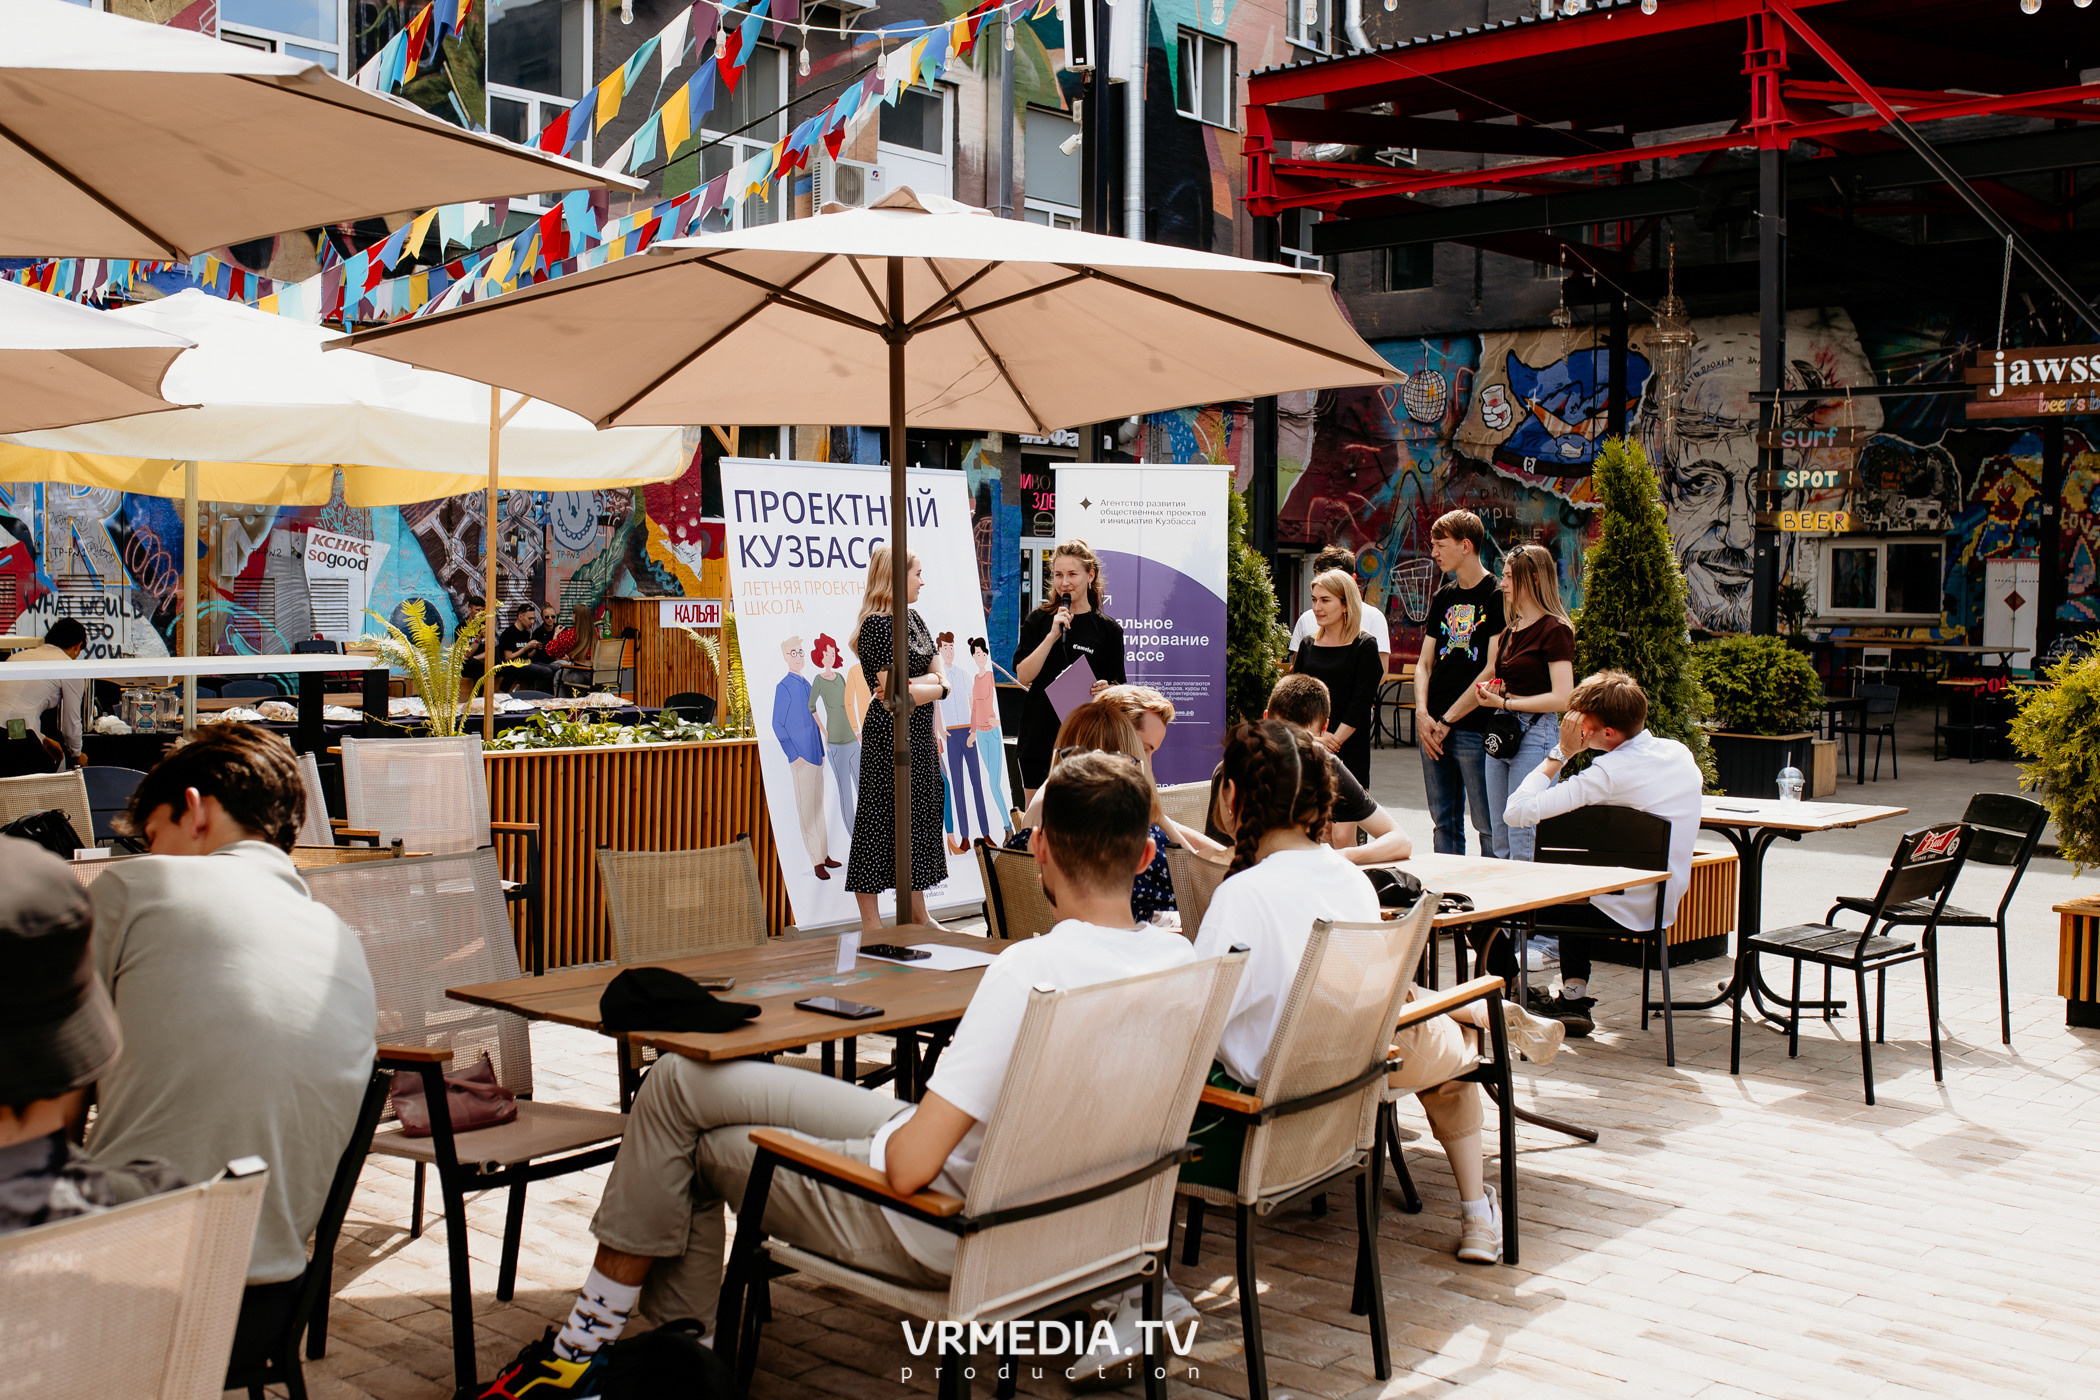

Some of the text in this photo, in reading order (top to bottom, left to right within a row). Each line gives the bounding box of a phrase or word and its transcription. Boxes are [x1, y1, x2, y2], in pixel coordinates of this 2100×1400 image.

[1784, 470, 1838, 488] SPOT
[1032, 491, 1055, 511] ЗДЕ
[1100, 499, 1186, 508] Агентство развития
[1100, 508, 1207, 517] общественных проектов
[1108, 518, 1153, 526] инициатив
[1155, 518, 1197, 526] Кузбасса
[1784, 514, 1844, 530] BEER
[311, 534, 372, 557] KCHKC
[742, 580, 866, 597] ЛЕТНЯЯ ПРОЕКТН
[23, 592, 144, 620] WHAT WOULD
[675, 604, 719, 624] КАЛЬЯН
[744, 600, 804, 616] ШКОЛА
[1115, 618, 1173, 630] альное
[1122, 635, 1209, 648] тирование
[84, 644, 122, 660] YOU
[1126, 651, 1165, 662] ассе
